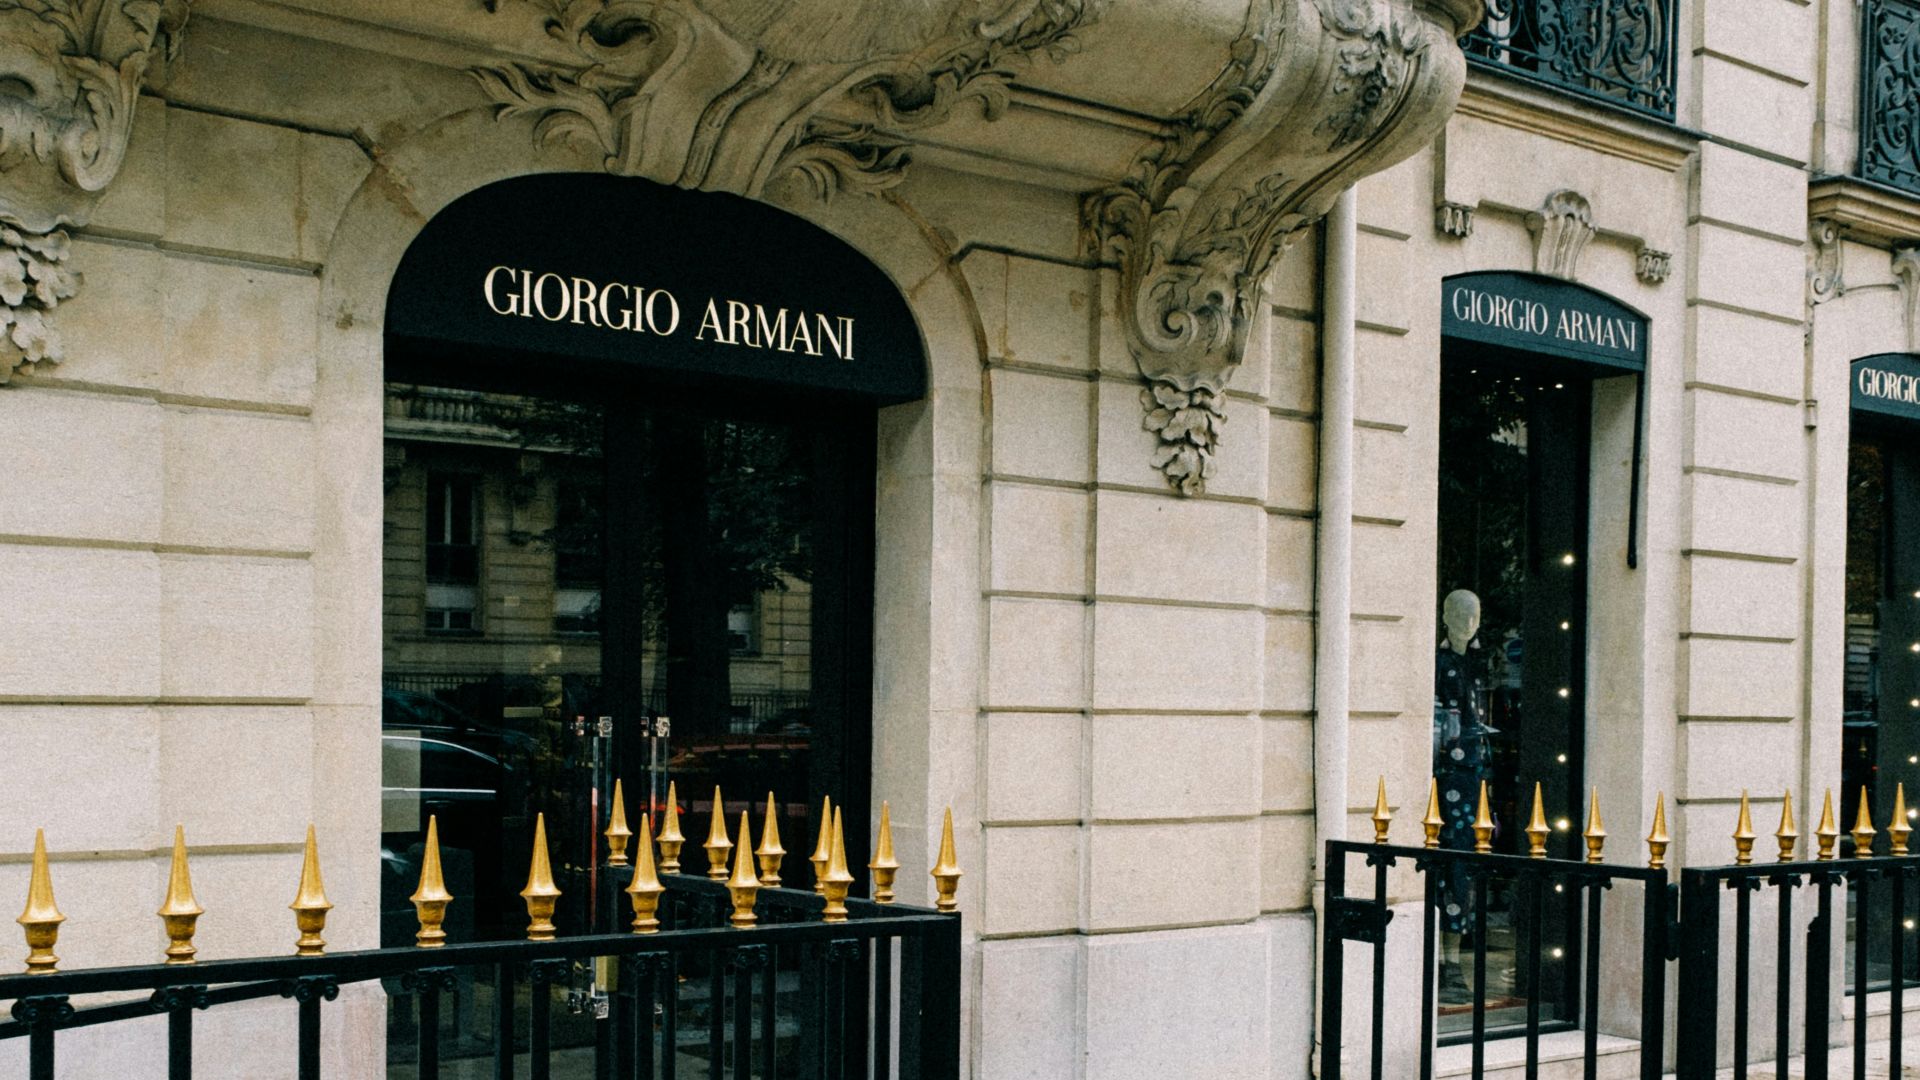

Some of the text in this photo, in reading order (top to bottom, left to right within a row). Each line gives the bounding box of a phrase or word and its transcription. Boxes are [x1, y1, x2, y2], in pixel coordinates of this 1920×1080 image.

[484, 266, 855, 360] GIORGIO ARMANI
[1453, 288, 1636, 352] GIORGIO ARMANI
